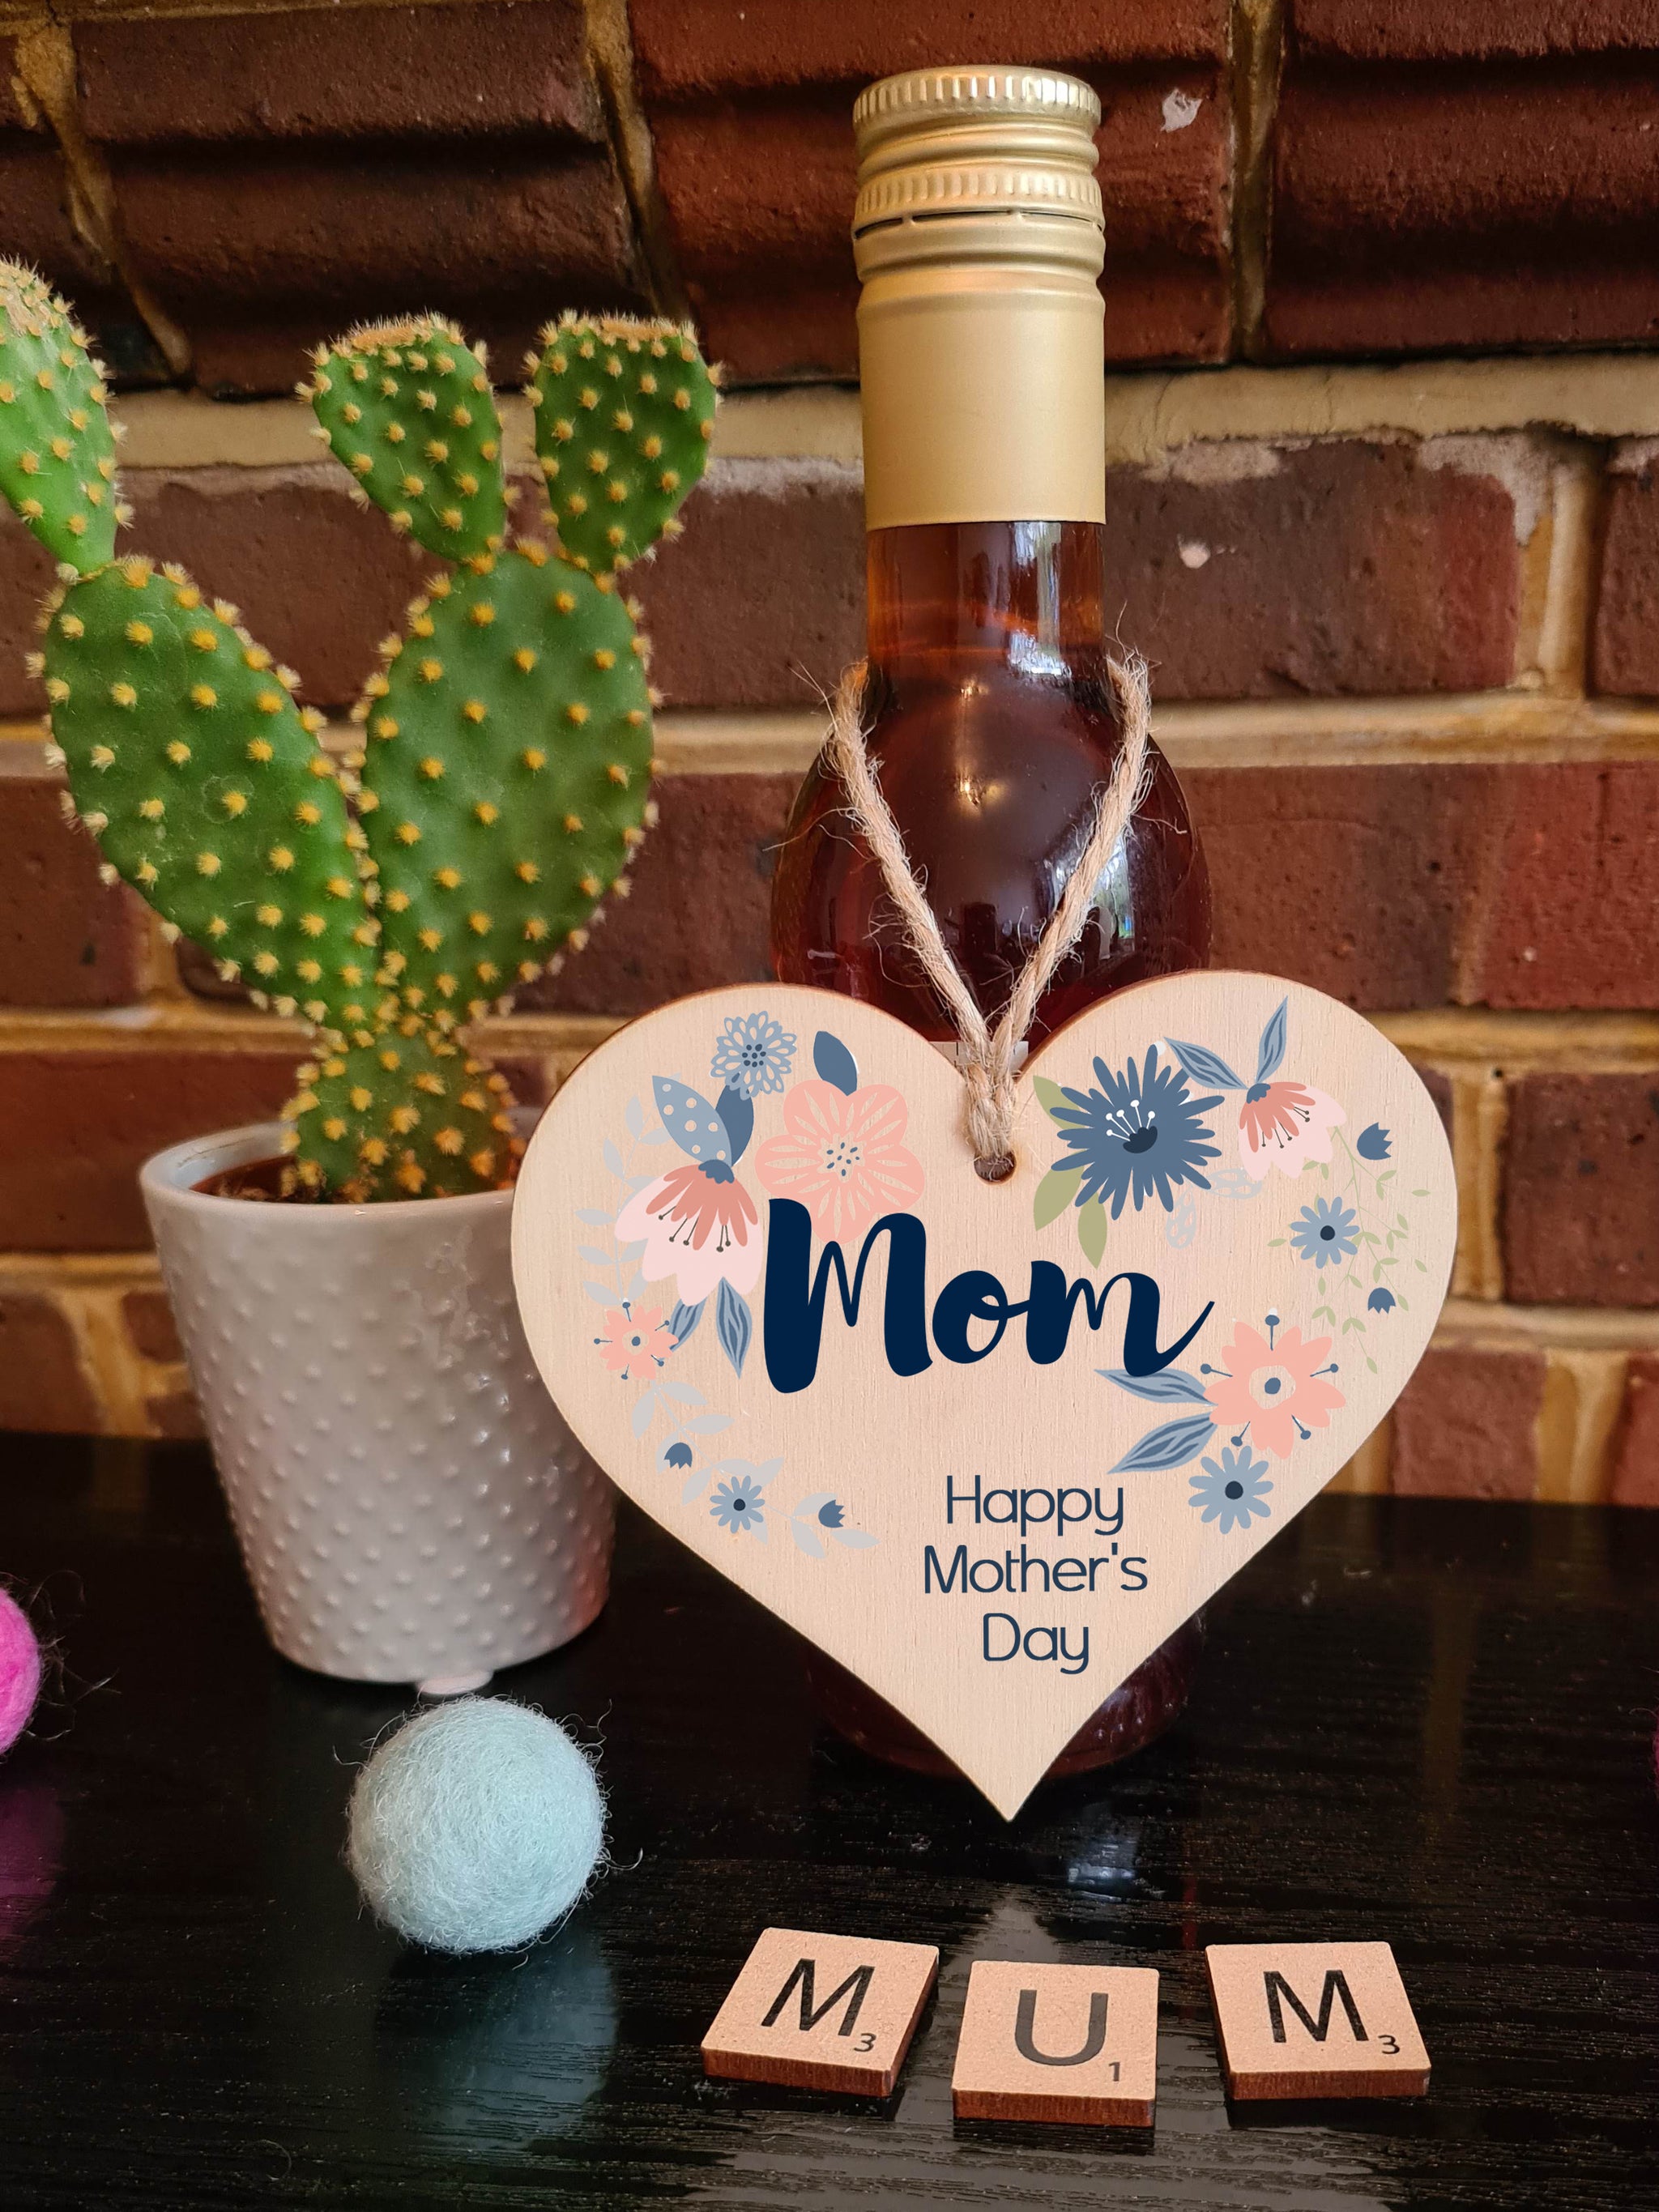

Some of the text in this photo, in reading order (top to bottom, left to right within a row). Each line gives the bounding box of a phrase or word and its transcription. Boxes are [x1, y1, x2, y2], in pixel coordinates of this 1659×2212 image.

[764, 1198, 1215, 1394] Mom
[946, 1475, 1124, 1537] Happy
[924, 1542, 1148, 1594] Mother's
[983, 1613, 1090, 1675] Day
[853, 2032, 877, 2052] 3
[1378, 2034, 1401, 2055] 3
[1108, 2061, 1120, 2082] 1
